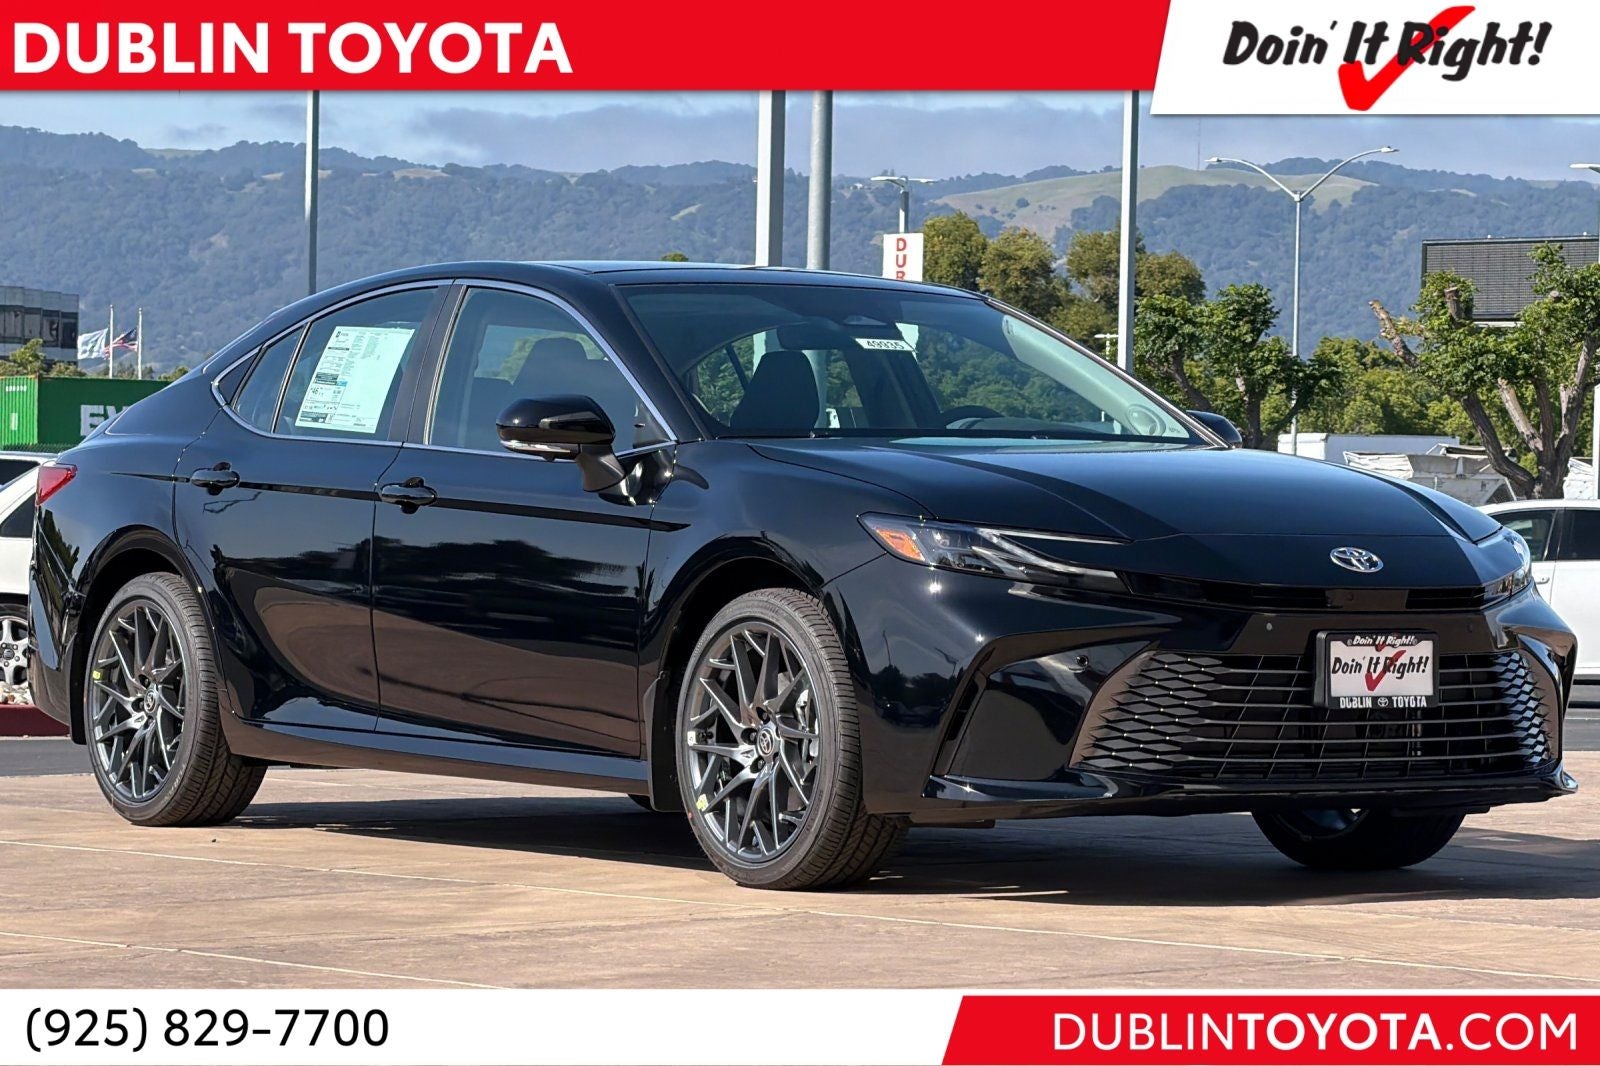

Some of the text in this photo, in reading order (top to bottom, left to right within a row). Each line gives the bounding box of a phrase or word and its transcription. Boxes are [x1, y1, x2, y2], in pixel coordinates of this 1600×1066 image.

[1352, 635, 1416, 648] Doin' It Right!
[1331, 656, 1430, 680] Doin' It Right!
[1340, 695, 1427, 709] DUBLIN TOYOTA
